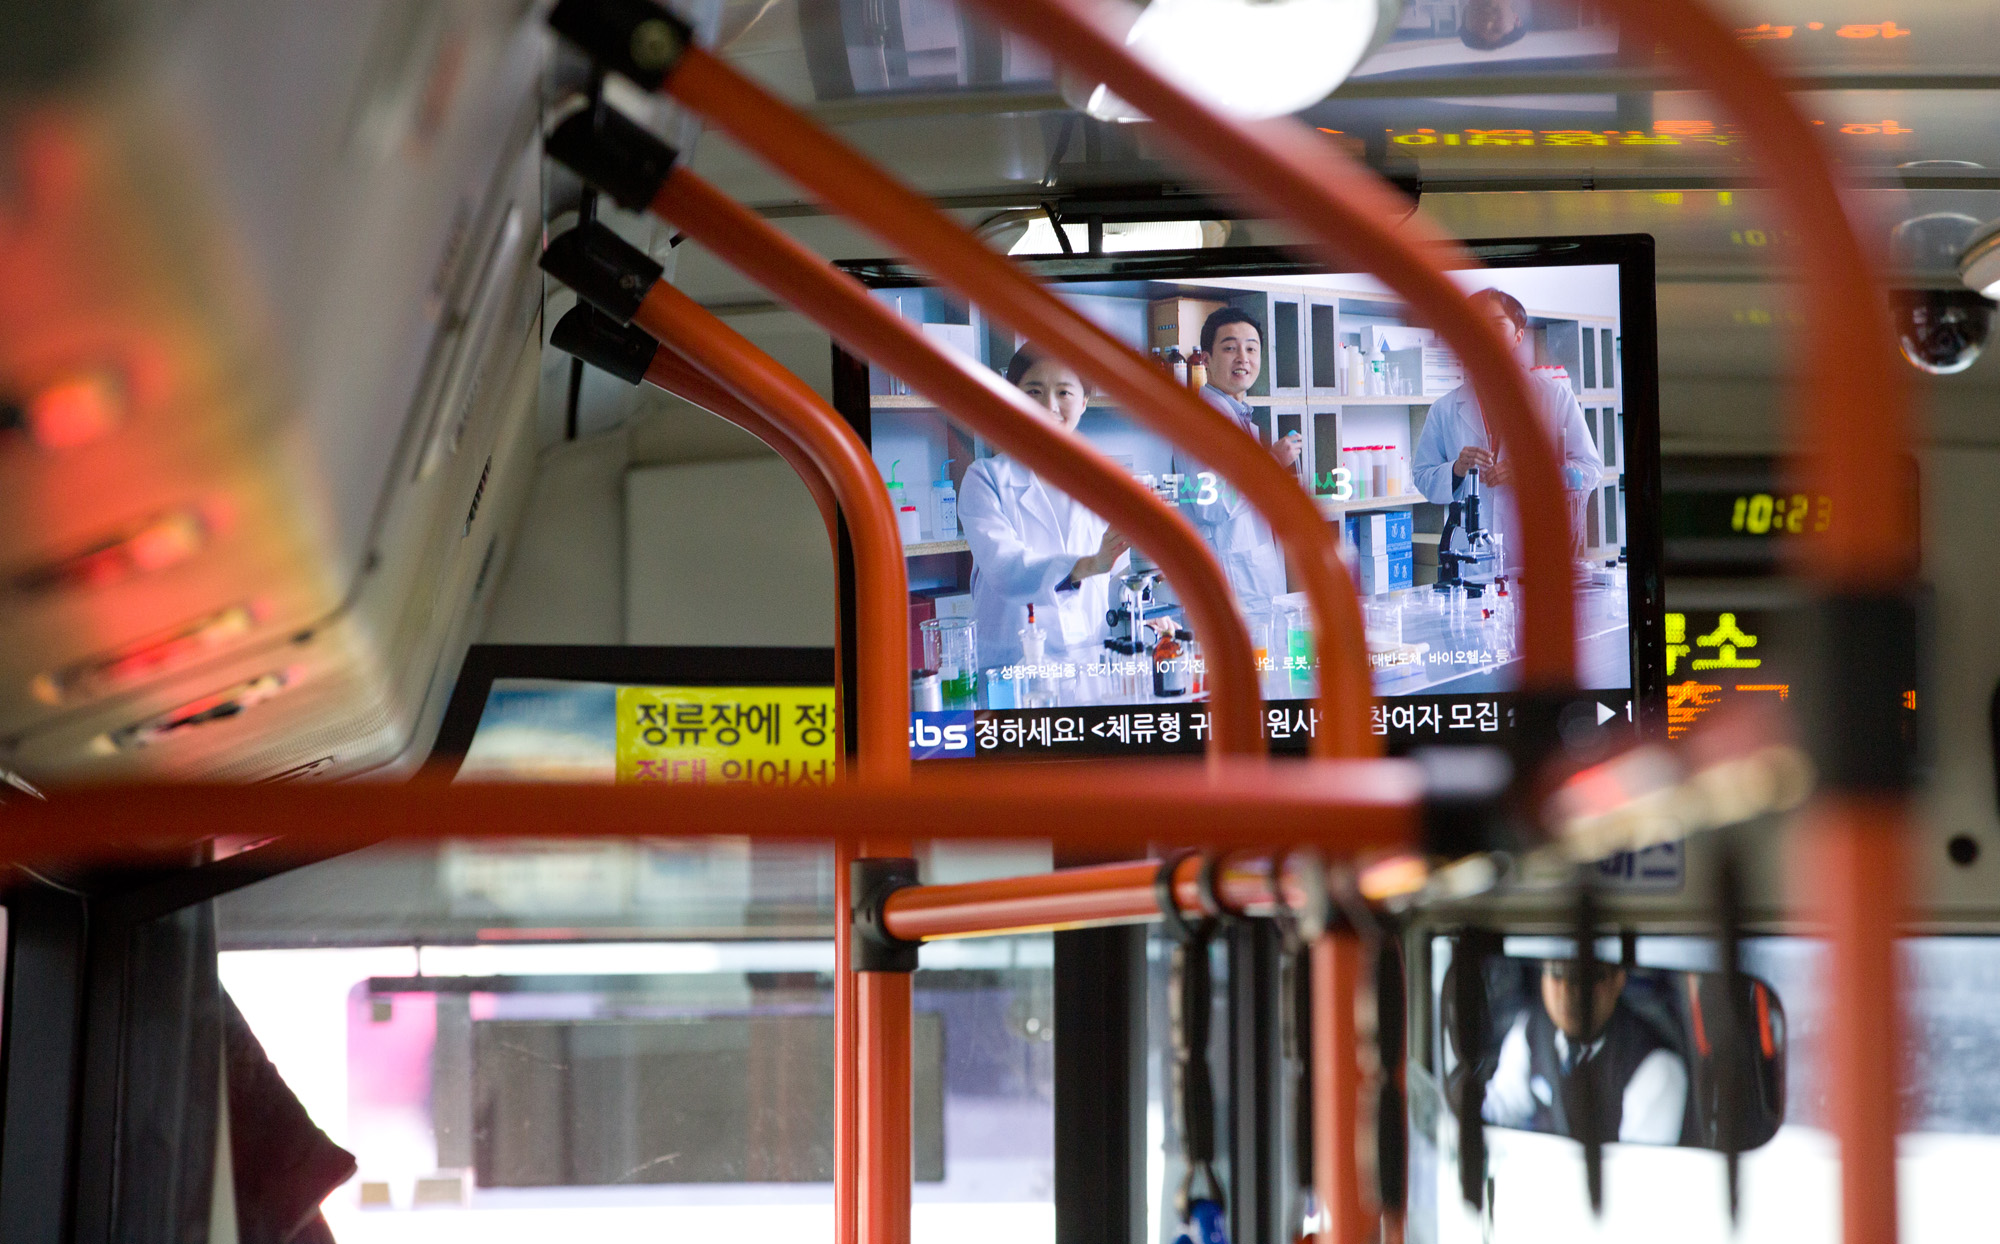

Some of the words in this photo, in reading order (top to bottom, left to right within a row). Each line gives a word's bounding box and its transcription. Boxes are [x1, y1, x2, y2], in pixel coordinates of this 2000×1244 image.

[1731, 494, 1832, 534] 10:23
[1000, 663, 1076, 680] 성장유망업종
[1086, 661, 1153, 677] 전기자동차,
[1156, 660, 1178, 674] IOT
[1282, 654, 1311, 671] 로봇,
[1428, 649, 1492, 666] 바이오헬스
[636, 703, 782, 747] 정류장에
[794, 703, 835, 747] 정
[975, 716, 1085, 750] 정하세요!
[1091, 711, 1181, 744] <체류형
[1370, 703, 1444, 736] 참여자
[1448, 701, 1500, 732] 모집
[721, 757, 836, 786] 일어서
